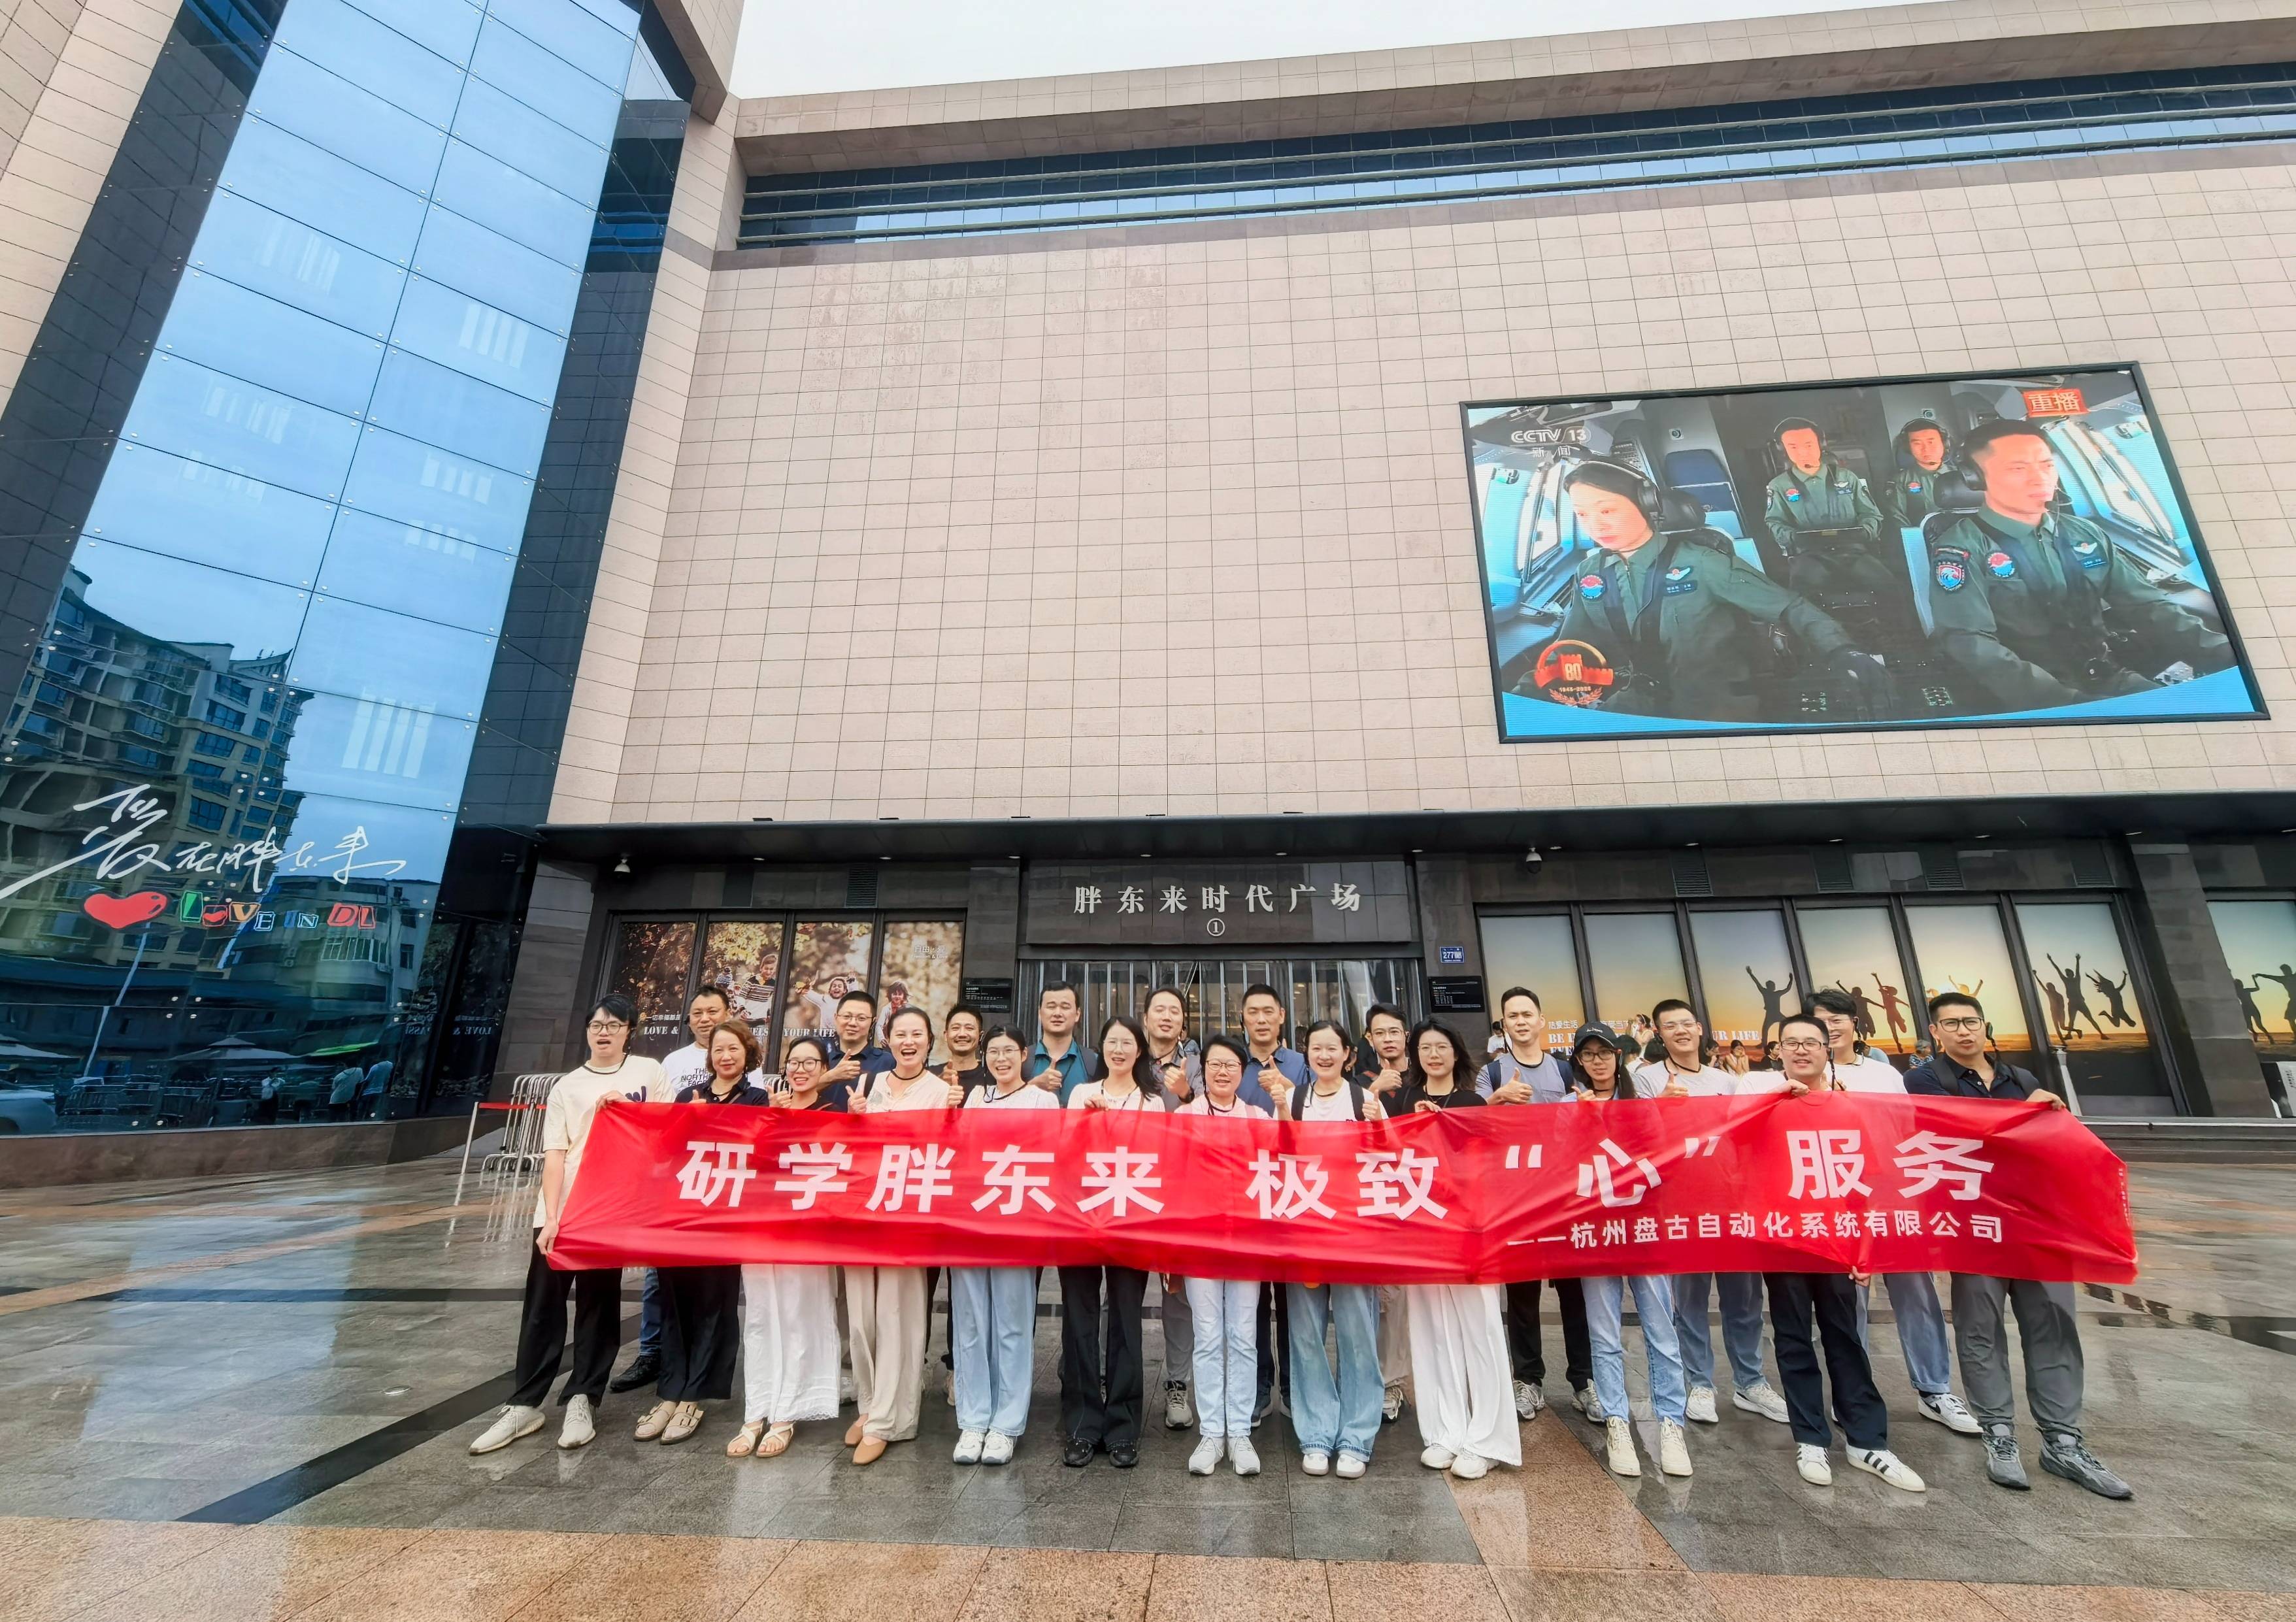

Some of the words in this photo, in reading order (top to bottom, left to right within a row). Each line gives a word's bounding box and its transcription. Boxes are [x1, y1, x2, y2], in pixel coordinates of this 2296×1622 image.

[2028, 392, 2080, 412] 重播
[1511, 429, 1561, 443] CCTV
[1569, 429, 1587, 441] 13
[1565, 663, 1582, 680] 80
[1074, 883, 1361, 914] 胖东来时代广场
[327, 902, 376, 929] DL
[644, 1026, 668, 1034] LOVE
[671, 1026, 679, 1034] &
[784, 1028, 810, 1037] YOUR
[814, 1028, 836, 1038] LIFE
[1548, 1033, 1565, 1044] BE
[1731, 1030, 1759, 1041] LIFE
[676, 1141, 1164, 1217] 研学胖东来
